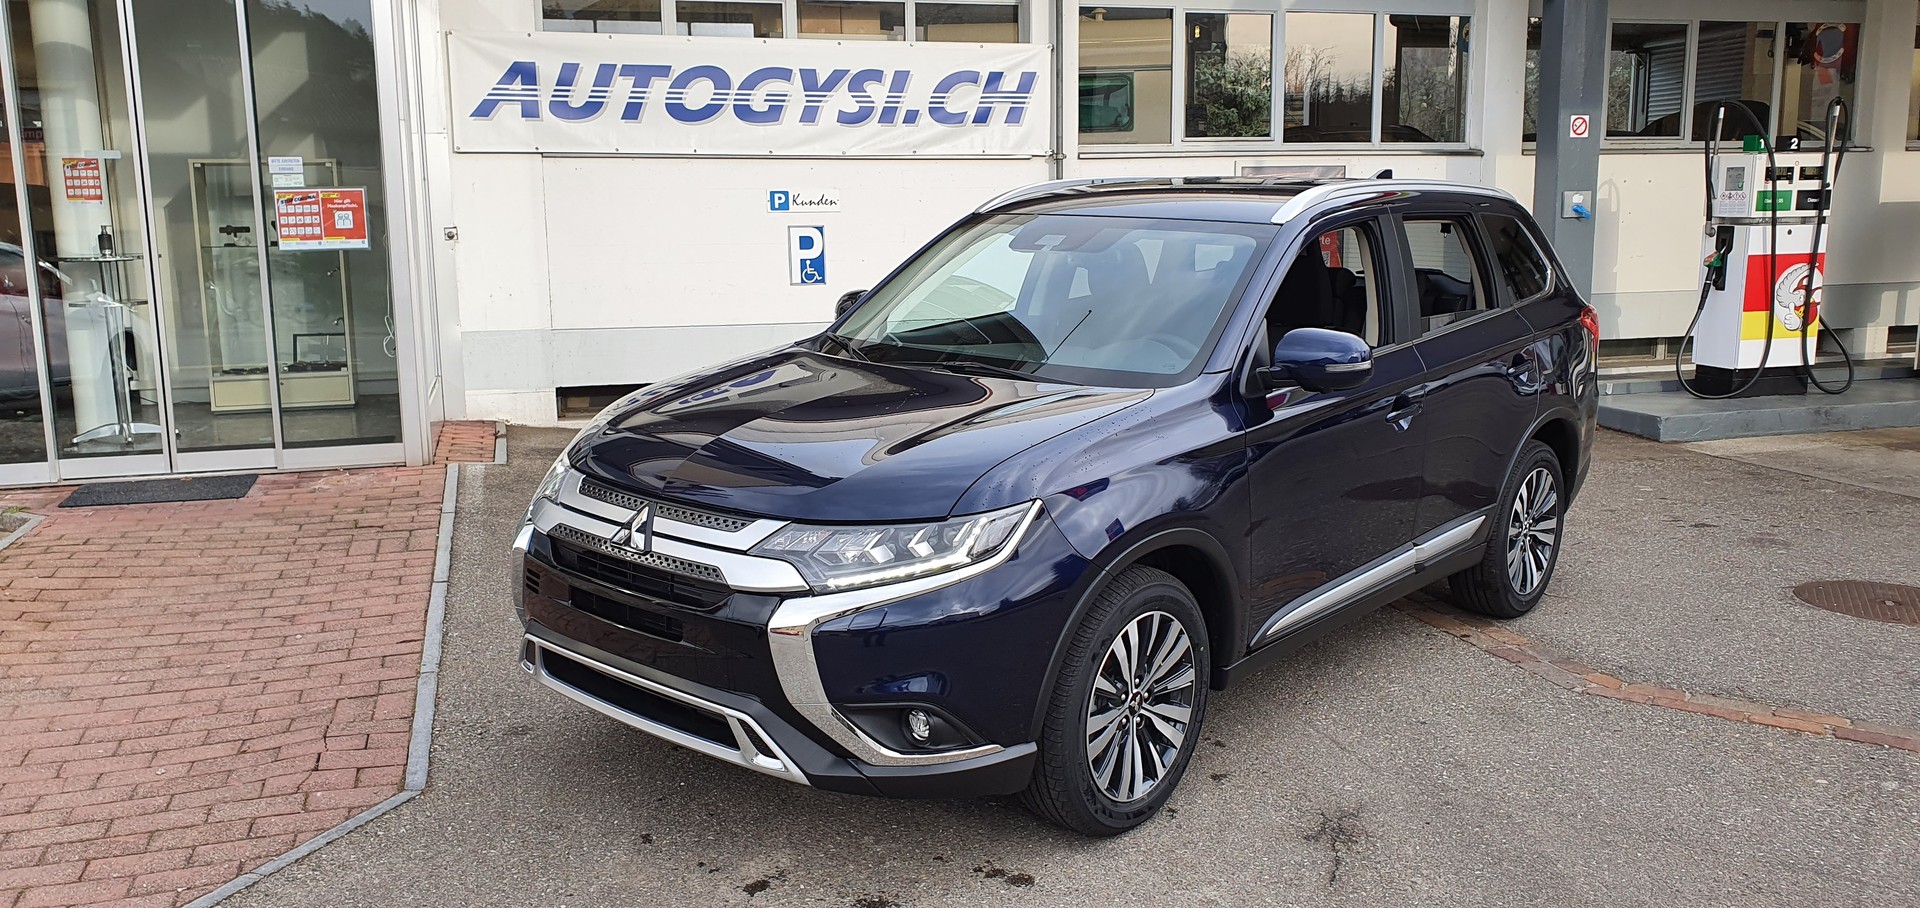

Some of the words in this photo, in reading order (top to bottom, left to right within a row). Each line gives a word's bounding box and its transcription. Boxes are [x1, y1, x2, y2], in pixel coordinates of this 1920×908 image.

[468, 60, 1039, 127] AUTOGYSI.CH
[1759, 138, 1765, 149] 1
[1790, 137, 1799, 149] 2
[774, 193, 786, 209] P
[792, 193, 837, 206] Kunden
[790, 226, 823, 283] P
